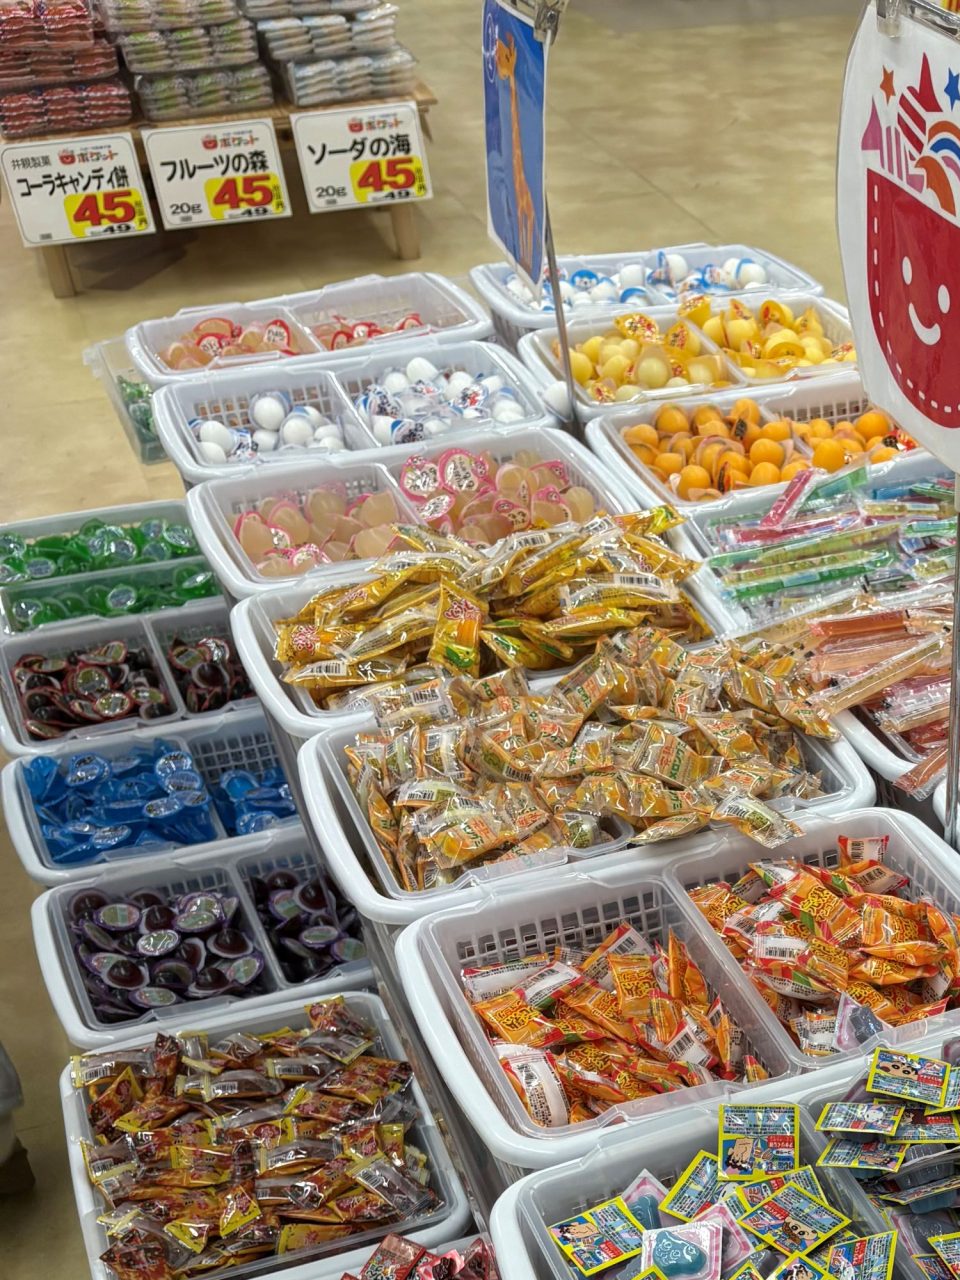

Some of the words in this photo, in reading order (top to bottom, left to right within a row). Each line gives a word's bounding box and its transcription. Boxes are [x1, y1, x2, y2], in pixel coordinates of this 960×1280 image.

[307, 133, 411, 165] ソーダの海
[17, 165, 129, 197] コーラキャンディ餅
[160, 150, 269, 182] フルーツの森
[357, 156, 416, 192] 45
[213, 174, 273, 209] 45
[315, 186, 347, 198] 20g
[73, 190, 136, 226] 45
[170, 203, 202, 215] 20g
